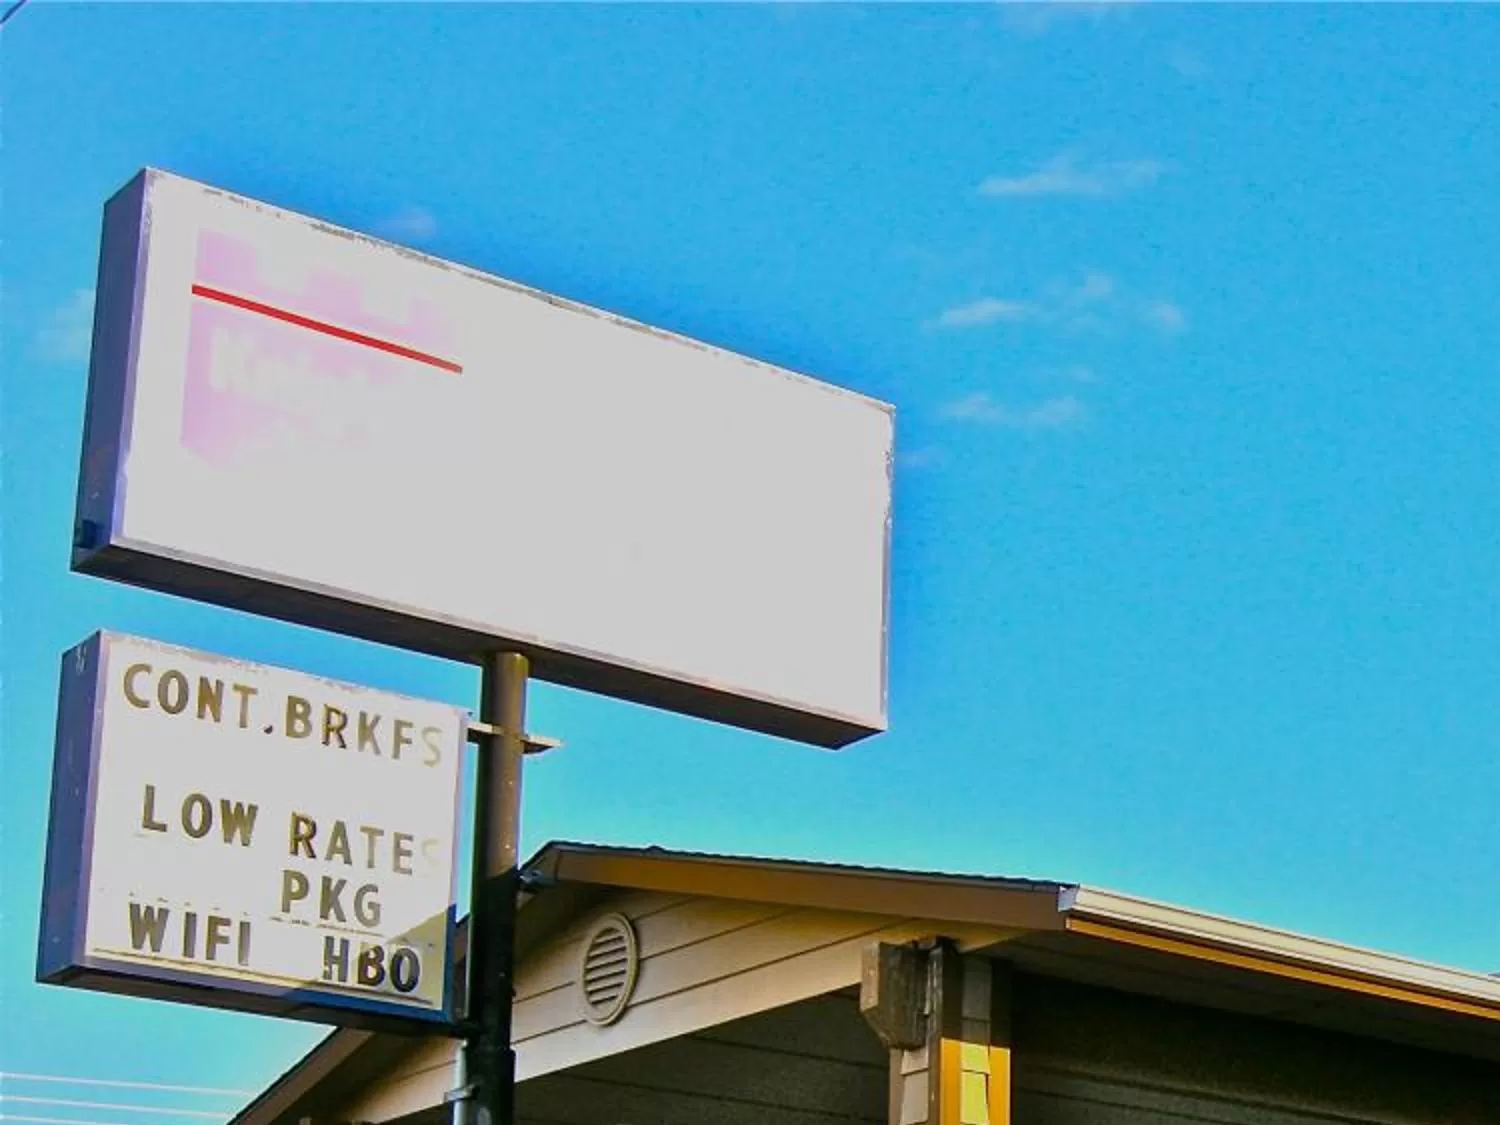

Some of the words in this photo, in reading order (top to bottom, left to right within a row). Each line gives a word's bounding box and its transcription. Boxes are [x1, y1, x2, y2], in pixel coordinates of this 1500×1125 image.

[141, 784, 259, 848] LOW
[281, 869, 382, 928] PKG
[128, 901, 252, 967] WIFI
[321, 934, 422, 995] HBO
